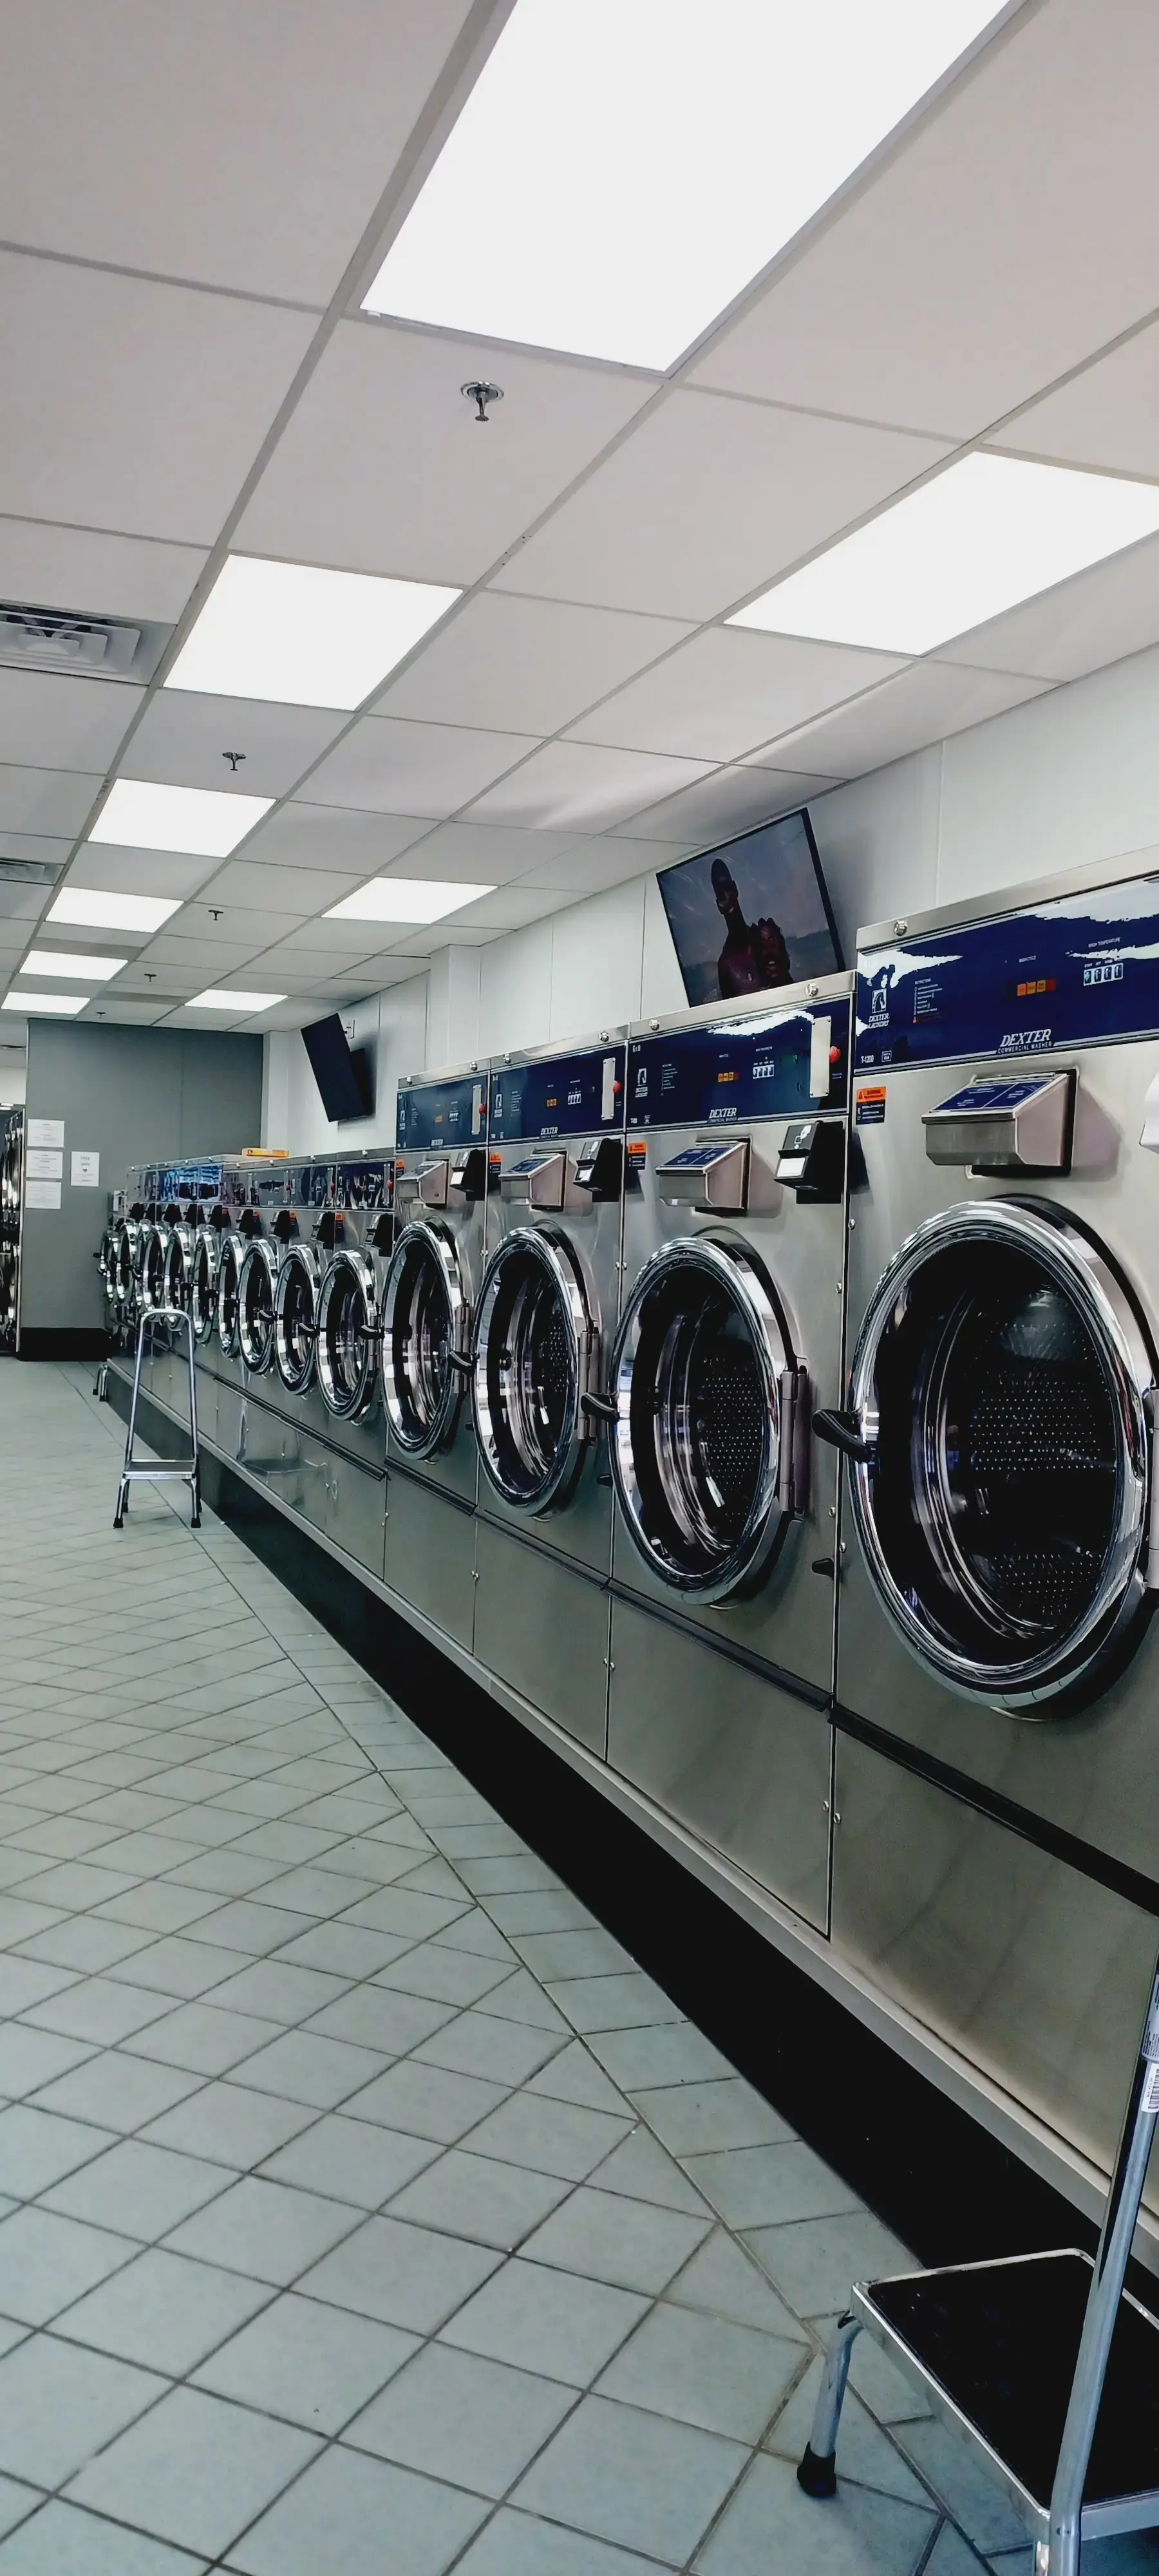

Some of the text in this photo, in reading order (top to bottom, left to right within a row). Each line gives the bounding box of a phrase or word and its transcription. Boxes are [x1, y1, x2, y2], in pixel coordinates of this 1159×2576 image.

[868, 1013, 889, 1023] DEXTER
[999, 1028, 1051, 1047] DEXTER
[997, 1041, 1052, 1054] COMMERCIAL WASHER
[860, 1055, 874, 1064] T-1200
[708, 1107, 737, 1119] DEXTER
[540, 1127, 558, 1135] DEXTER
